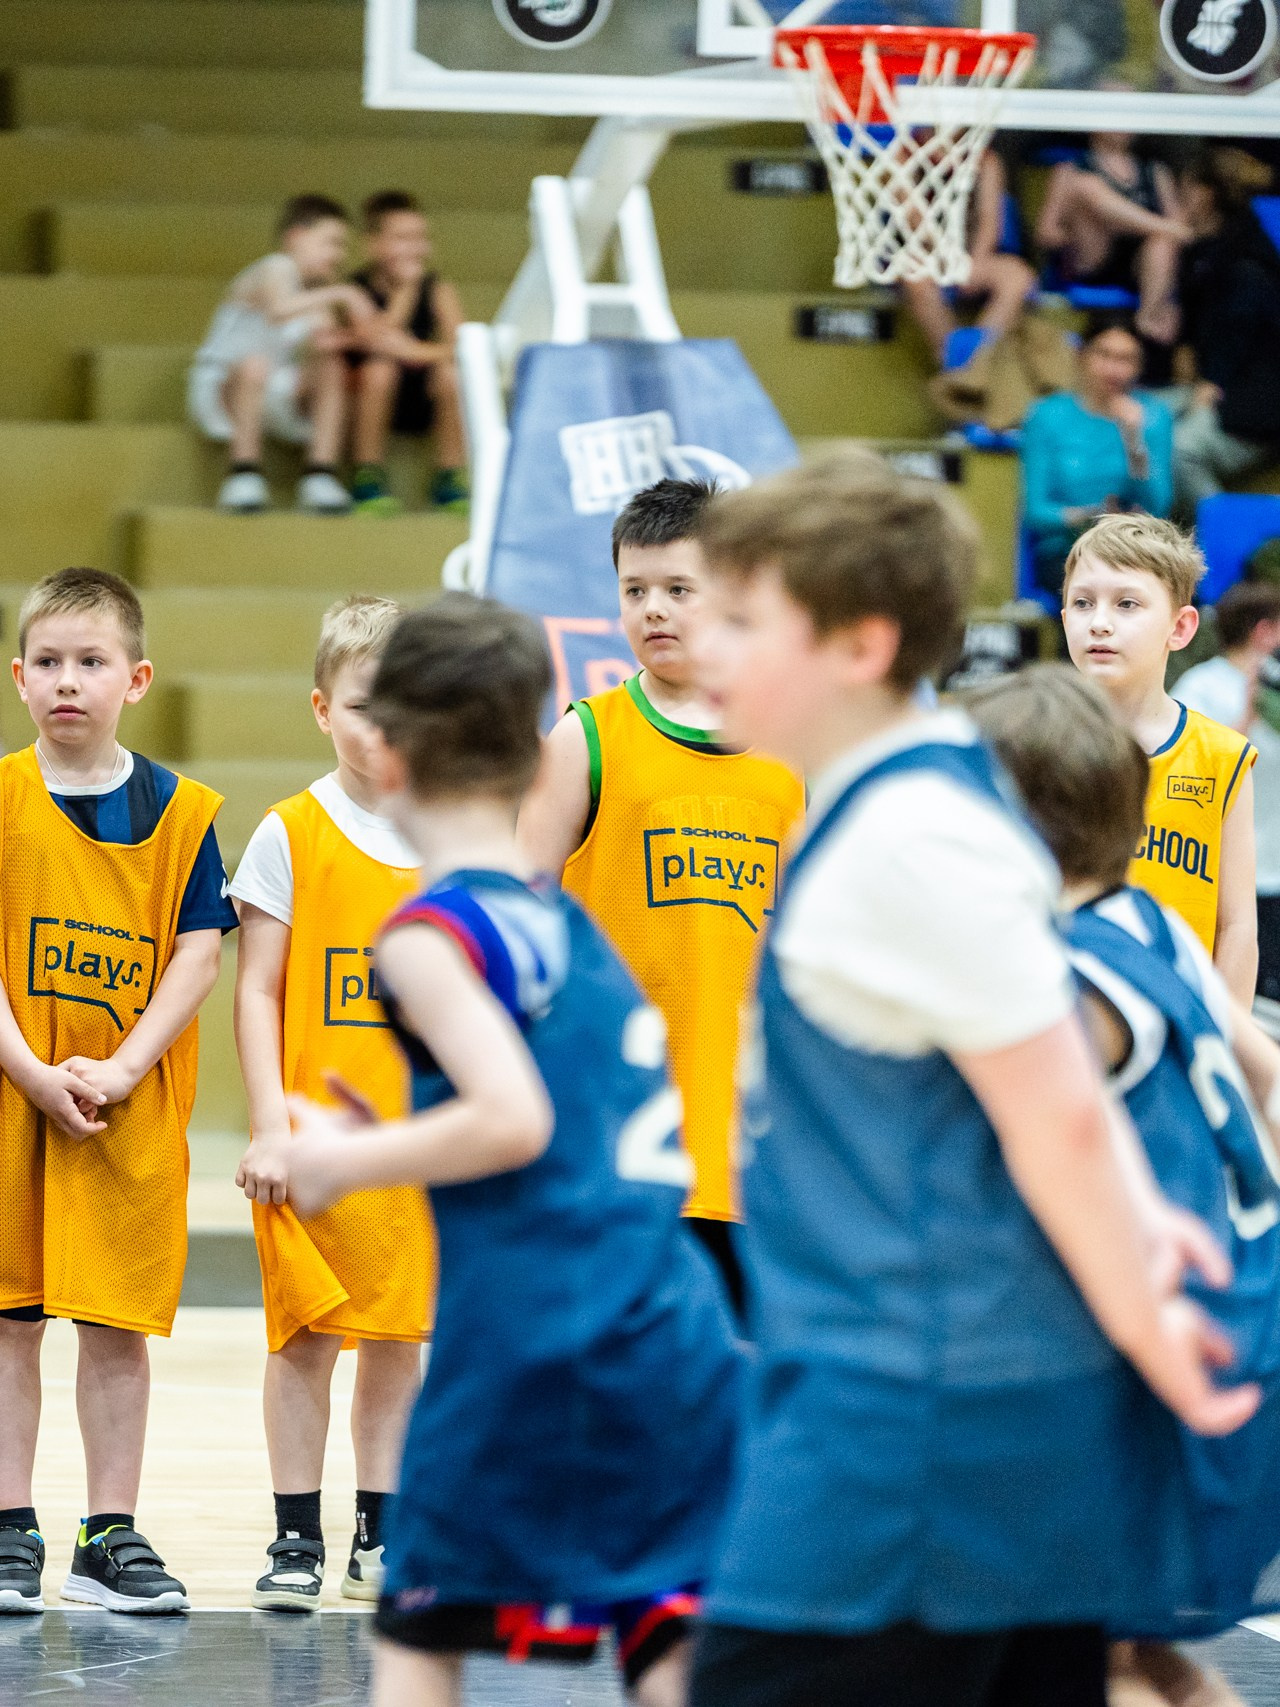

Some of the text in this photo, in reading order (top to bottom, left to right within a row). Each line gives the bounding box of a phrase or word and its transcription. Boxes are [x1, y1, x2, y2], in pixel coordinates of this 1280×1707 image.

[680, 827, 752, 843] SCHOOL
[662, 846, 765, 891] plays.
[63, 918, 135, 942] SCHOOL
[43, 940, 143, 991] plays.
